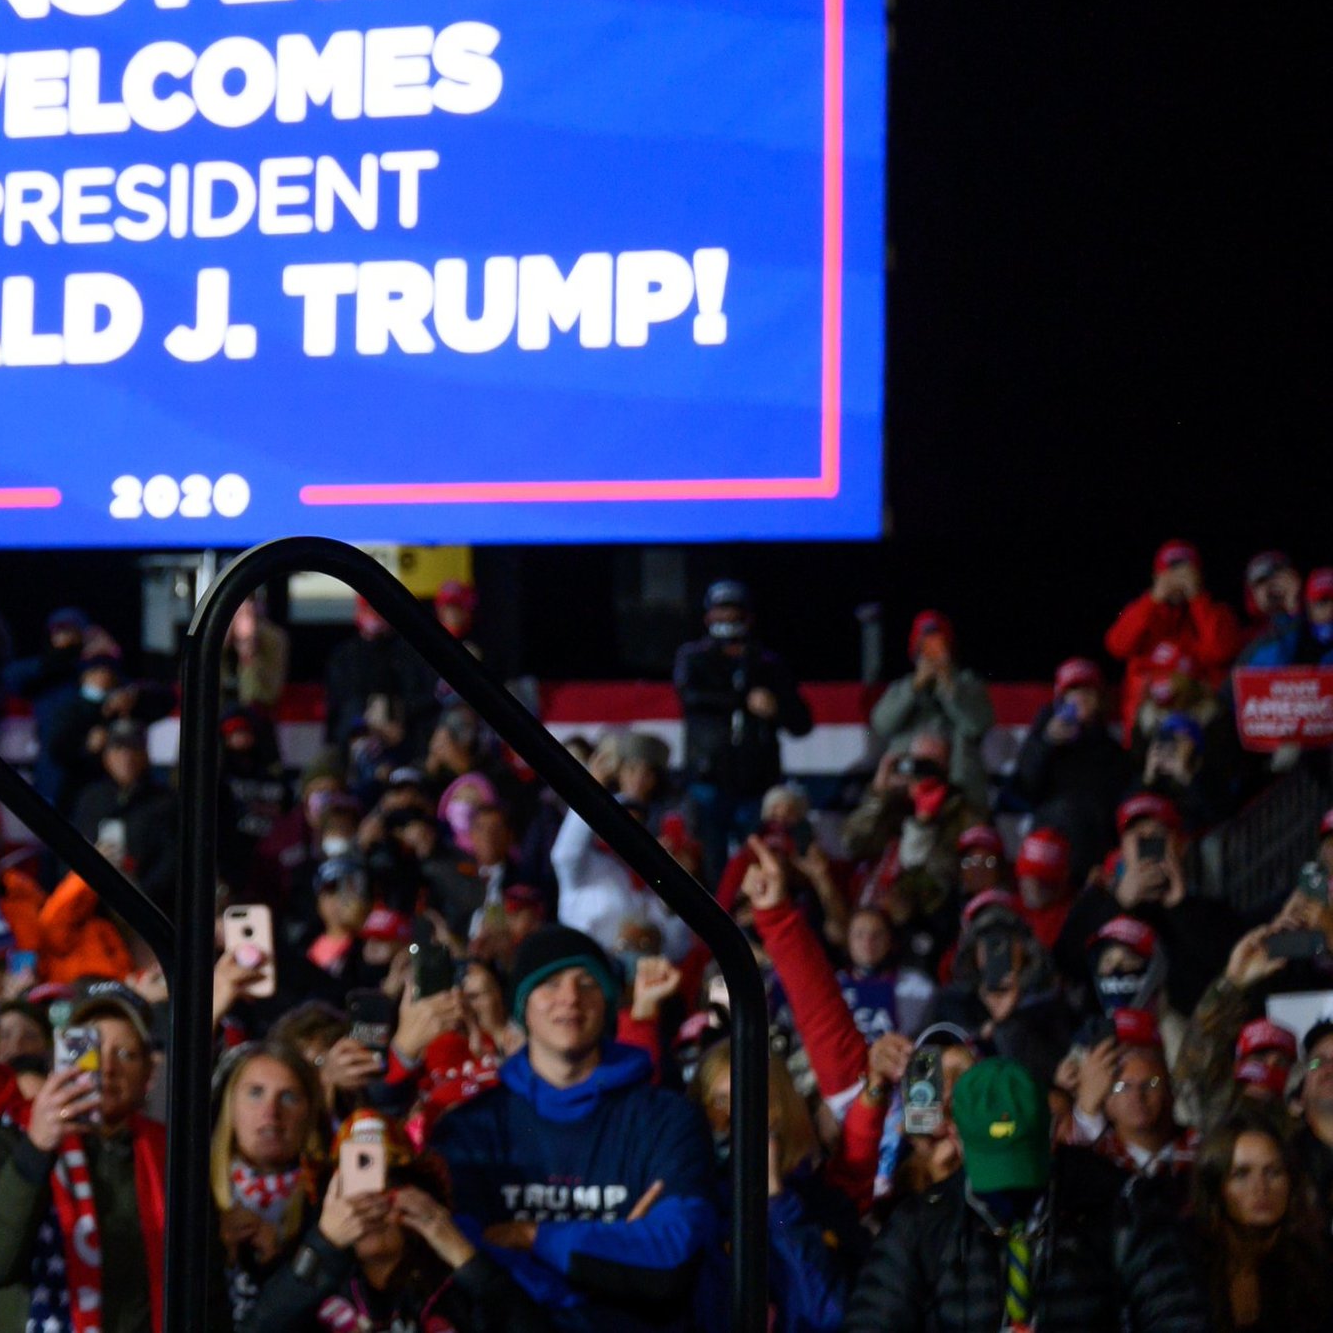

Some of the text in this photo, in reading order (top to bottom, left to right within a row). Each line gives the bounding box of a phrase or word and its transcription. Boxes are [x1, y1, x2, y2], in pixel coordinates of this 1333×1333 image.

[162, 266, 259, 364] J.
[281, 246, 731, 358] TRUMP!
[108, 472, 252, 520] 2020
[500, 1182, 629, 1211] TRUMP
